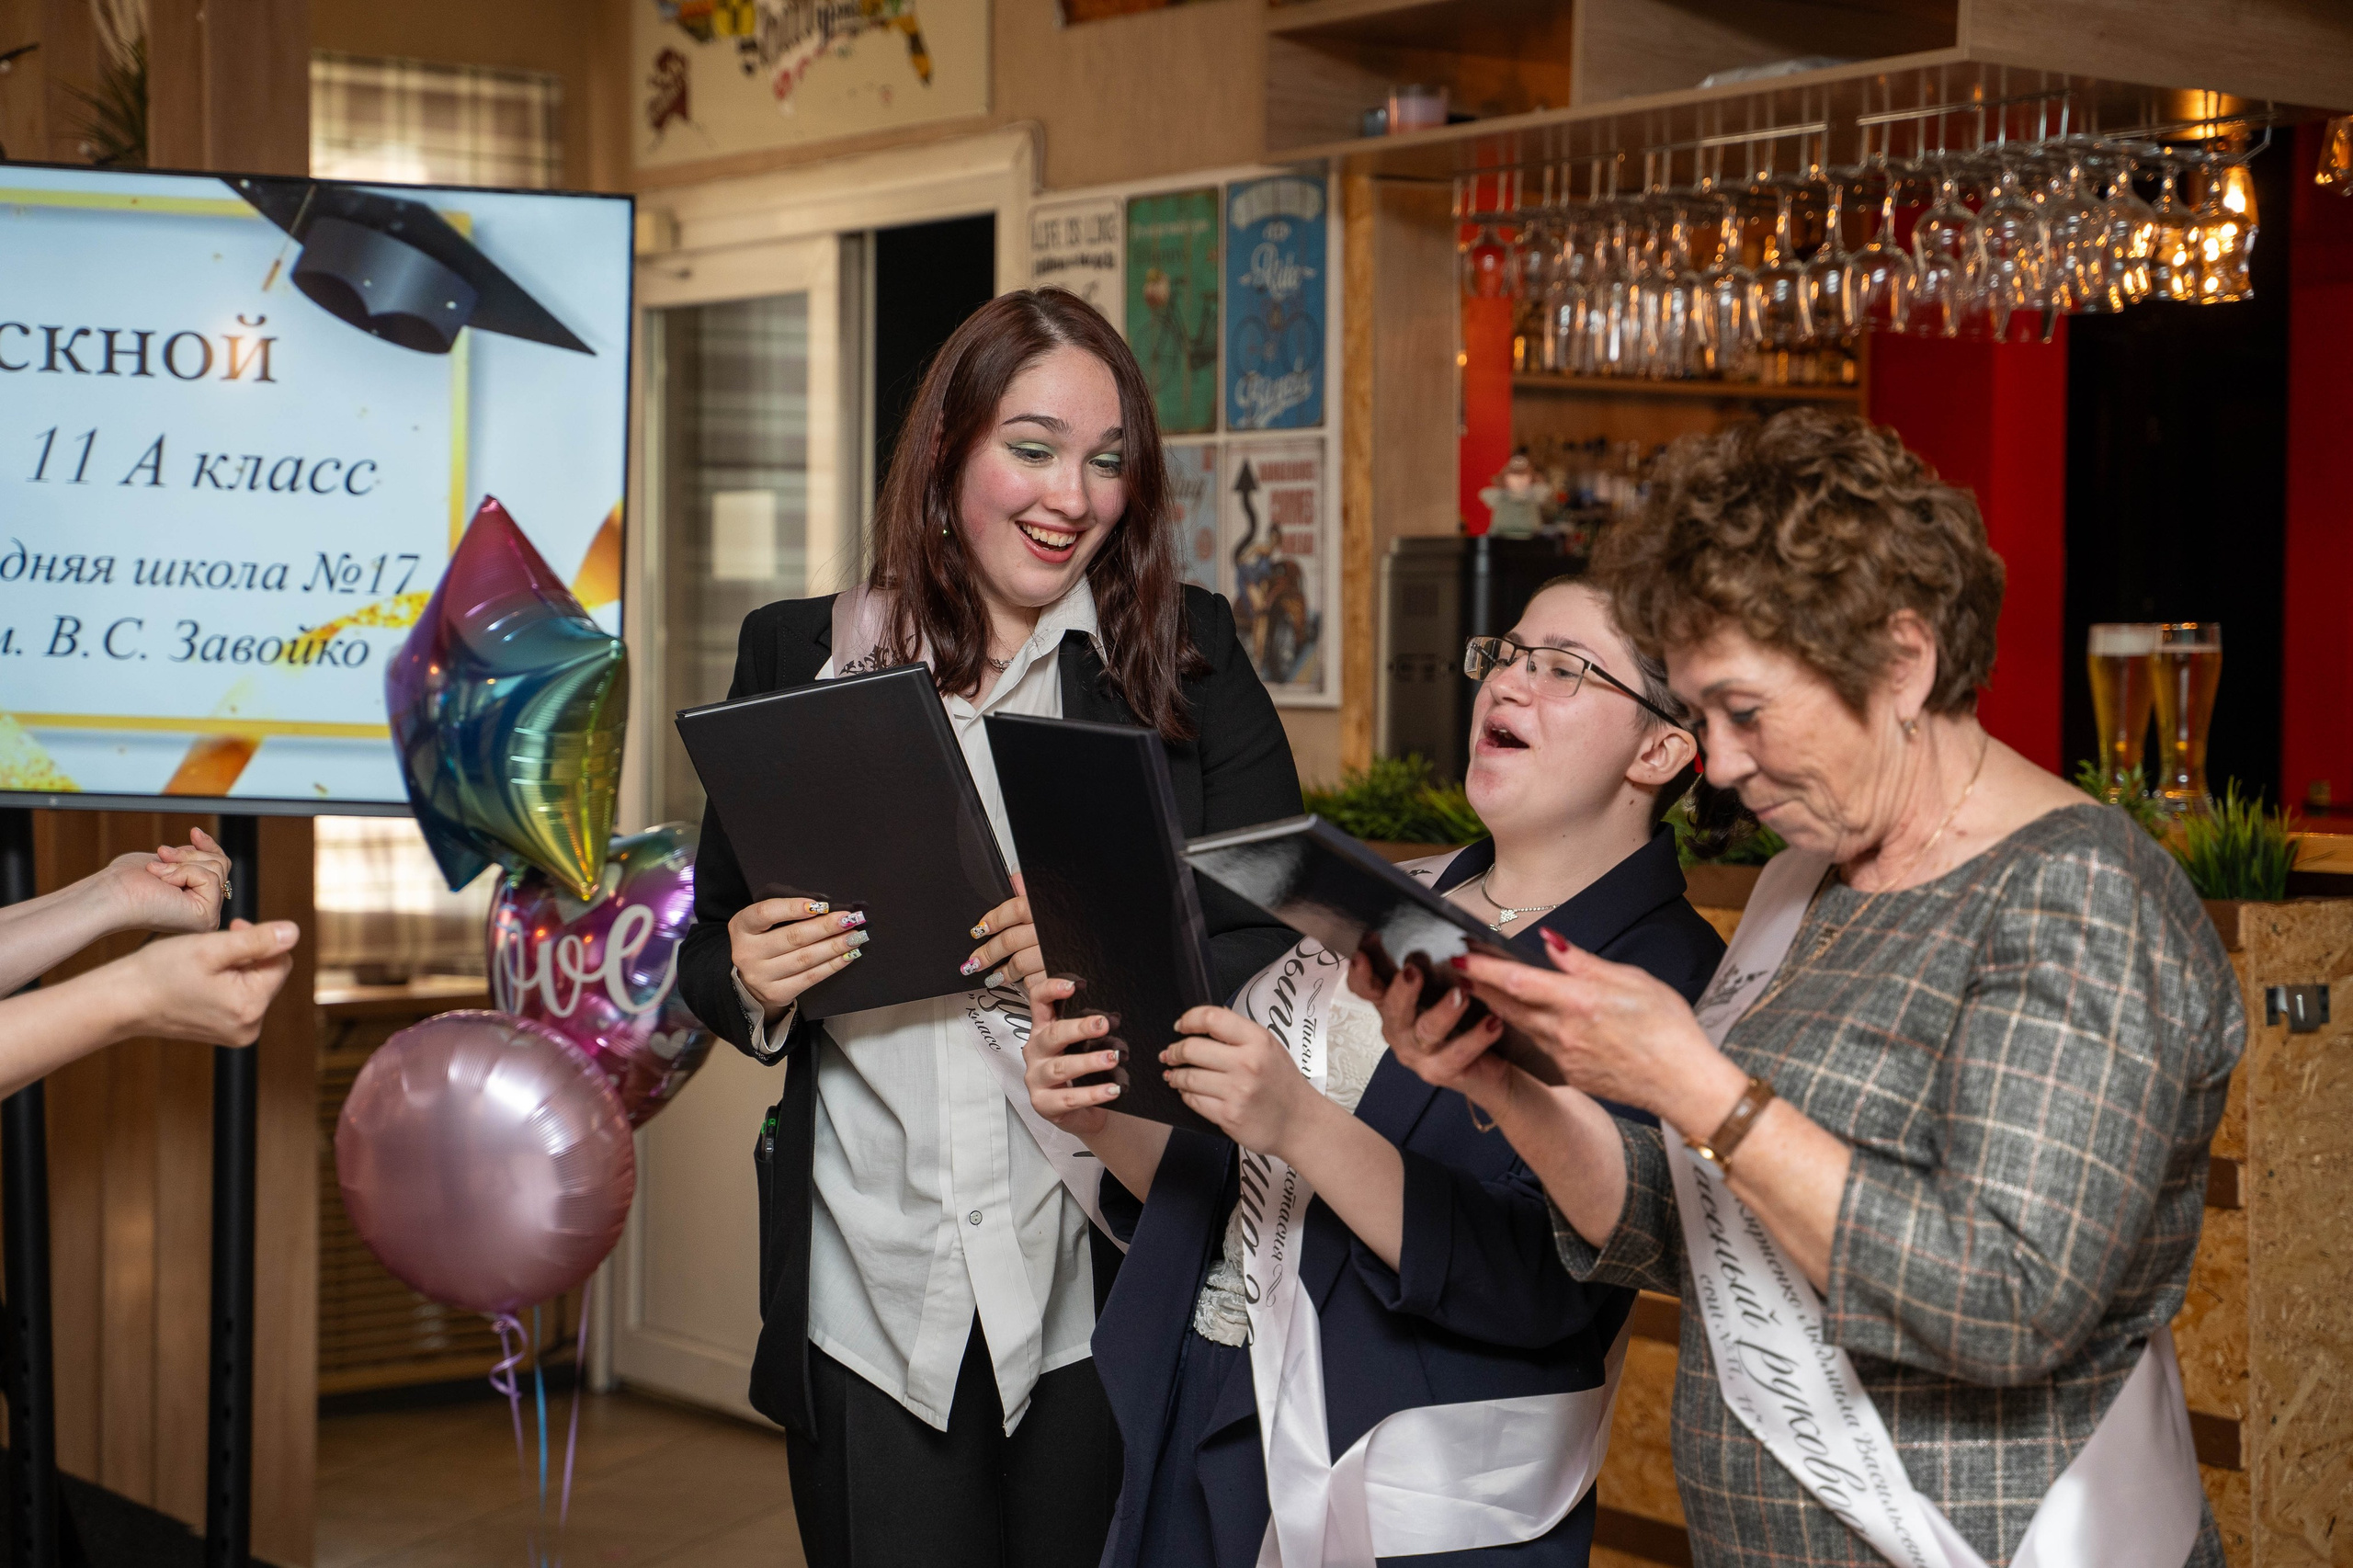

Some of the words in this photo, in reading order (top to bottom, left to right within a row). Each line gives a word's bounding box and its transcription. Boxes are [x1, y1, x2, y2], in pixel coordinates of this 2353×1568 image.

[26, 426, 97, 483] 11
[117, 432, 166, 487] А
[191, 452, 378, 496] класс
[0, 538, 114, 583] дняя
[133, 556, 290, 591] школа
[301, 551, 421, 596] №17
[168, 619, 370, 668] Завойко
[493, 903, 678, 1018] ove
[965, 1007, 1001, 1052] класс
[1270, 1165, 1297, 1261] астасия
[1692, 1164, 1780, 1328] ассный
[1853, 1431, 1929, 1568] Васильевн
